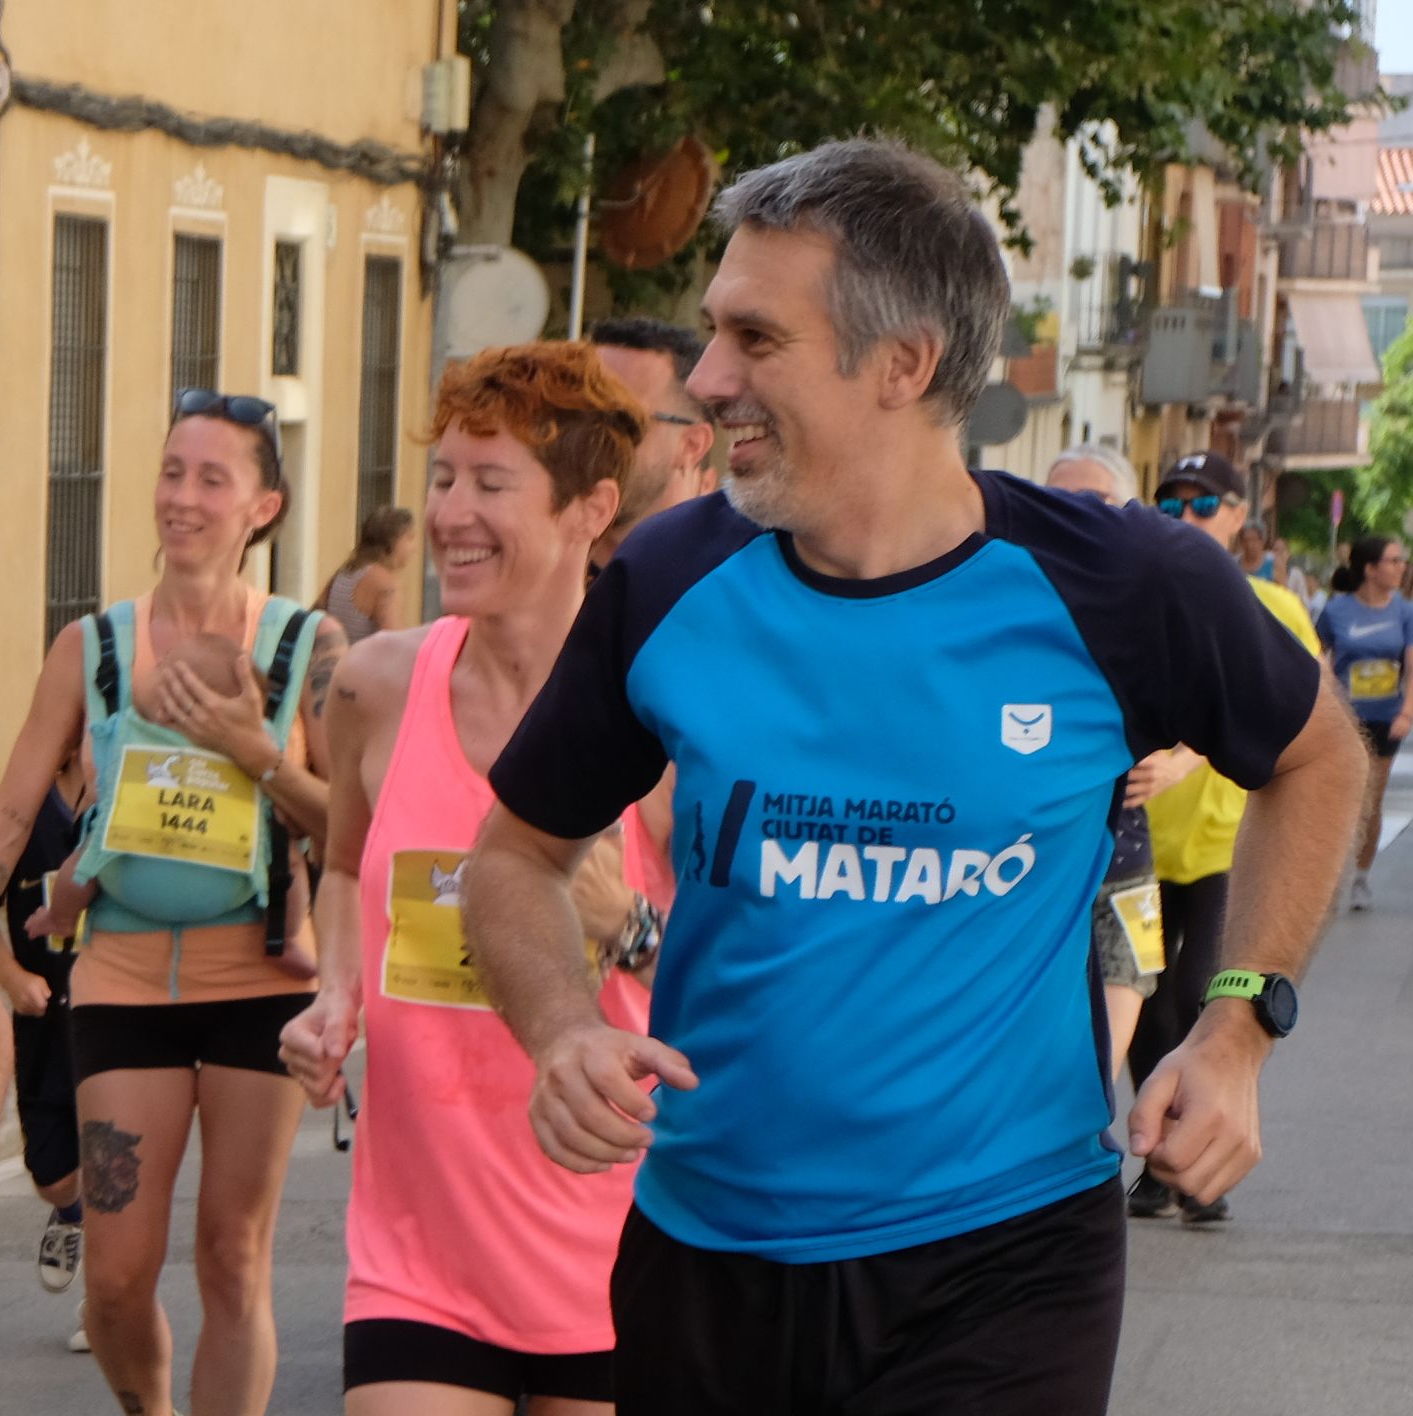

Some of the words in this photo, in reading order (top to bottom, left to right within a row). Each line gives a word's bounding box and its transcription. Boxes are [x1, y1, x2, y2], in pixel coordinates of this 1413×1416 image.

[158, 790, 215, 813] LARA
[762, 792, 834, 818] MITJA
[844, 797, 956, 825] MARATÓ
[160, 812, 208, 834] 1444
[761, 818, 848, 842] CIUTAT
[858, 825, 893, 846] DE
[759, 832, 1037, 905] MATARÓ
